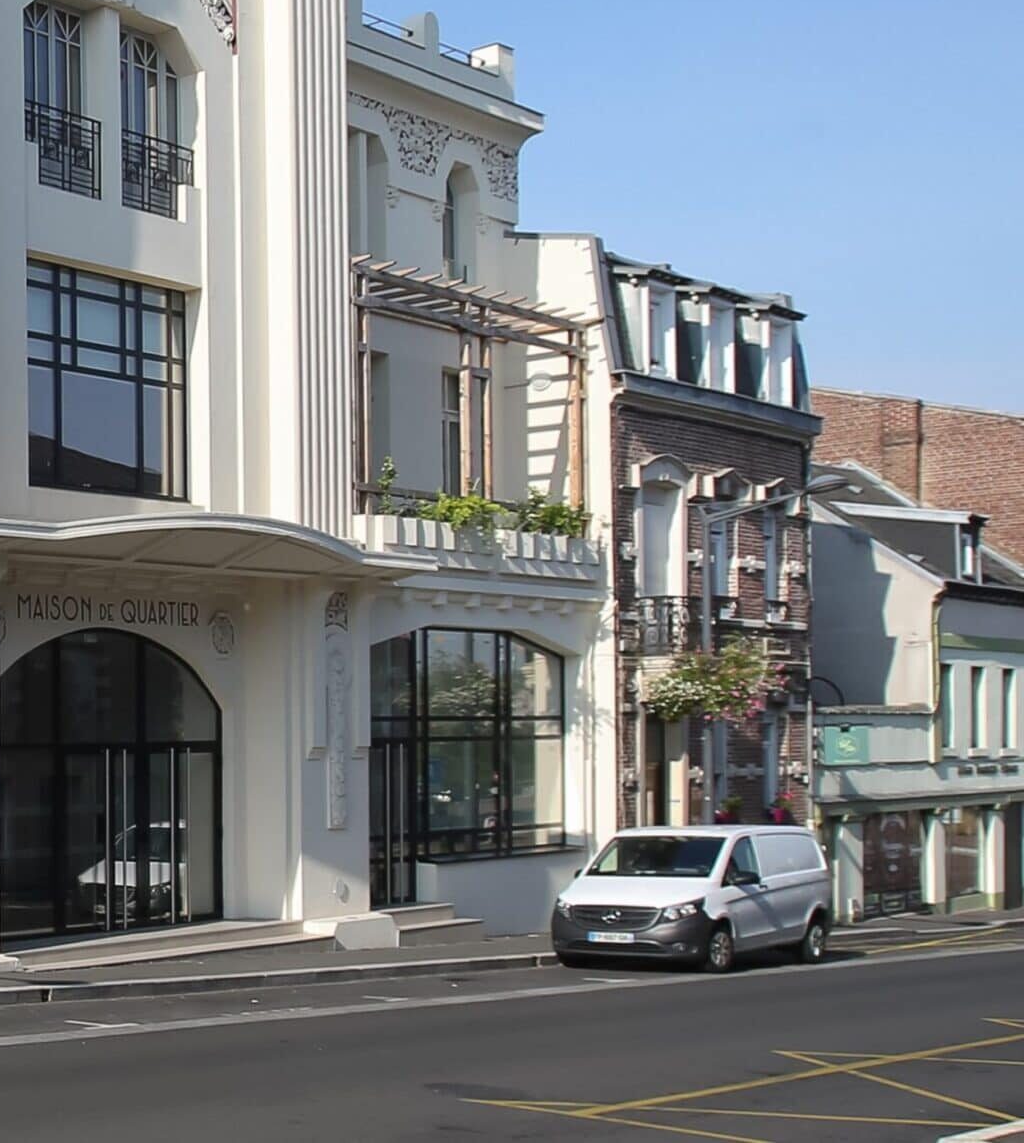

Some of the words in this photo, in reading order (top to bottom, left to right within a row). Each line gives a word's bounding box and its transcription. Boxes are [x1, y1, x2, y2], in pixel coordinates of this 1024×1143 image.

[17, 593, 92, 622] MAISON
[99, 603, 114, 621] DE
[120, 599, 199, 627] QUARTIER
